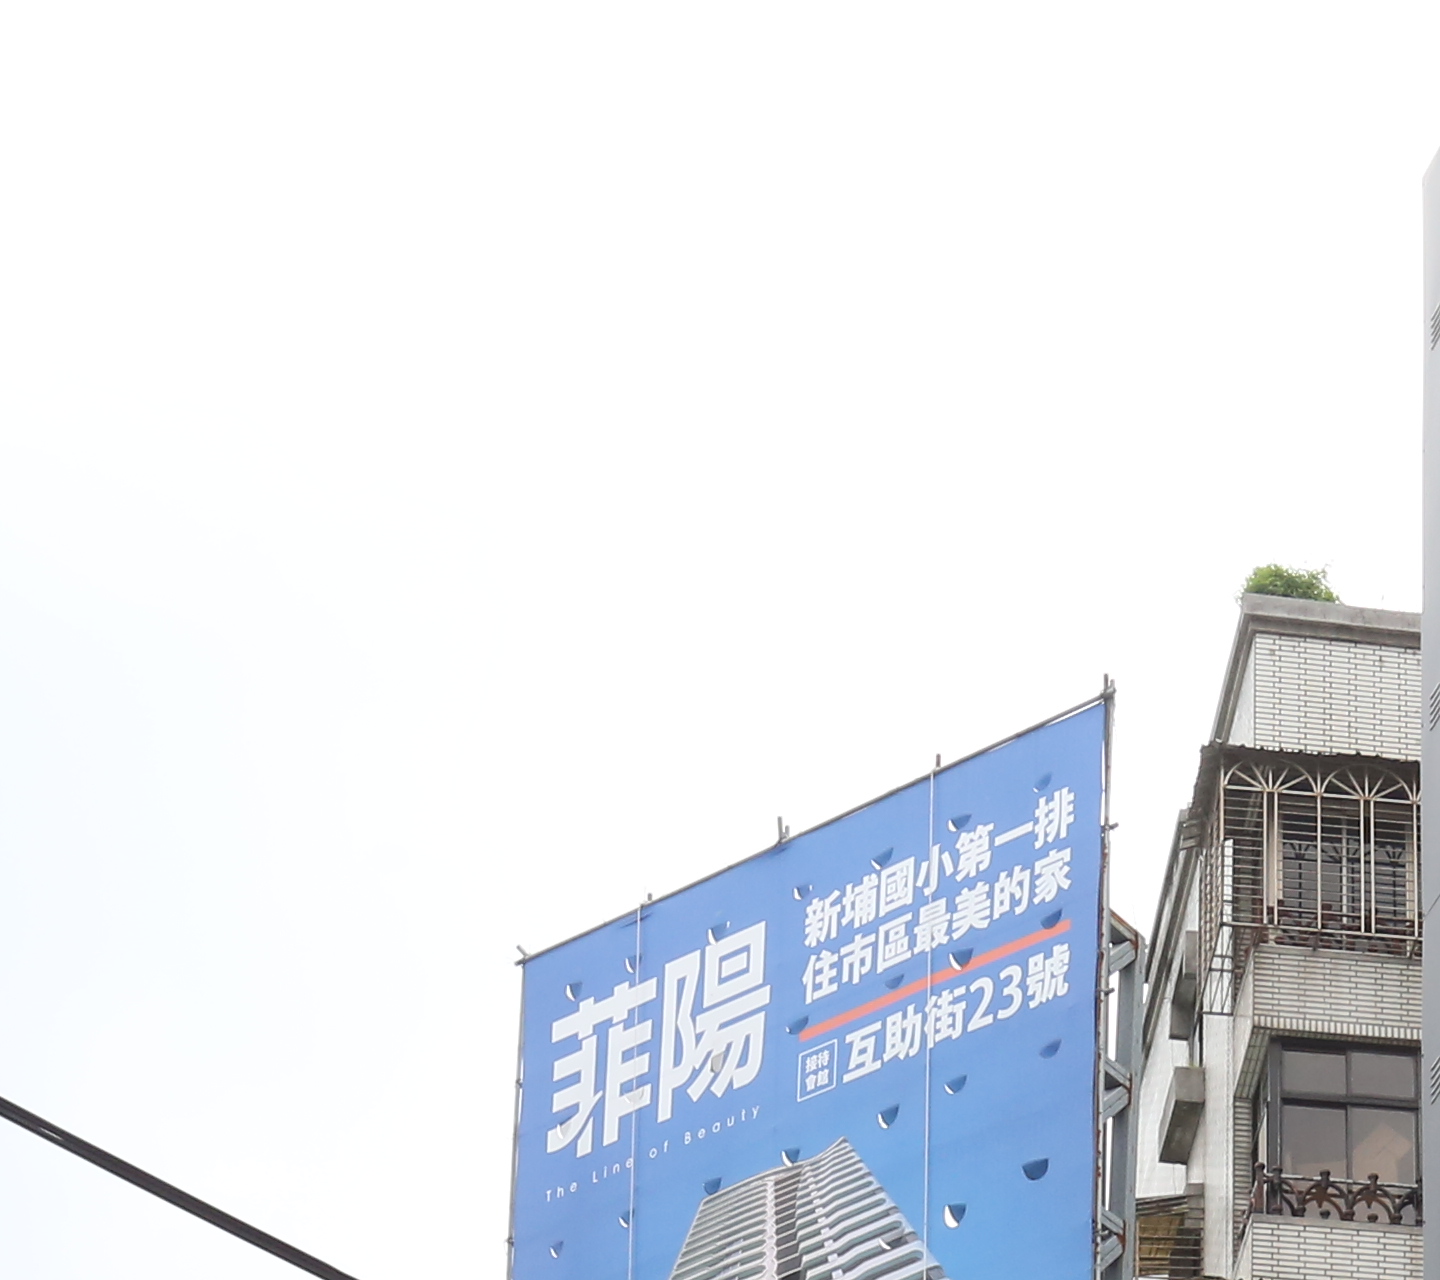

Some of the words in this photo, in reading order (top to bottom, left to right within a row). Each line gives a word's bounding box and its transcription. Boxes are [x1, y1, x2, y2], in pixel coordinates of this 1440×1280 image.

[802, 849, 1073, 1004] 住市區最美的家
[803, 787, 1076, 947] 新埔國小第一排
[545, 921, 771, 1157] 菲陽
[804, 1049, 831, 1073] 接待
[804, 1070, 830, 1093] 會館
[842, 942, 1070, 1083] 互助街23號
[544, 1178, 578, 1203] The
[591, 1156, 634, 1185] Line
[648, 1138, 670, 1163] of
[683, 1105, 762, 1147] Beauty
